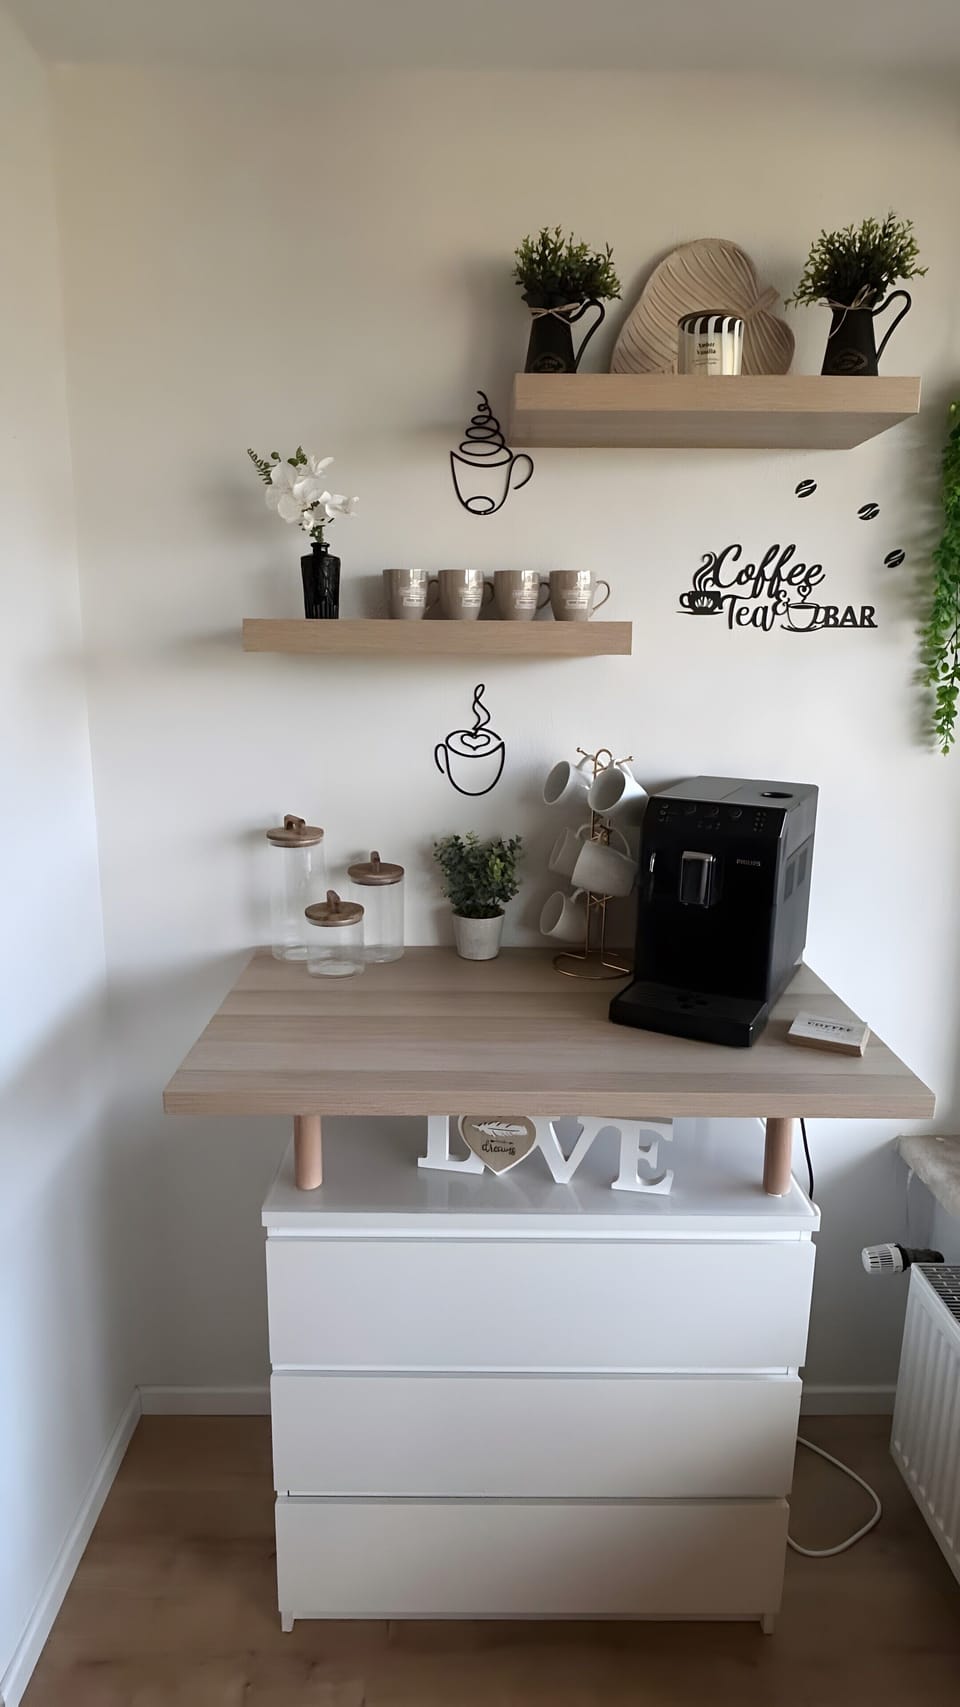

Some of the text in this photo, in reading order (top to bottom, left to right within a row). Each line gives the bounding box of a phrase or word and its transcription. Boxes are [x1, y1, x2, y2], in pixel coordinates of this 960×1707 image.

[714, 544, 826, 598] Coffee
[721, 594, 776, 631] Tea
[824, 606, 878, 628] BAR
